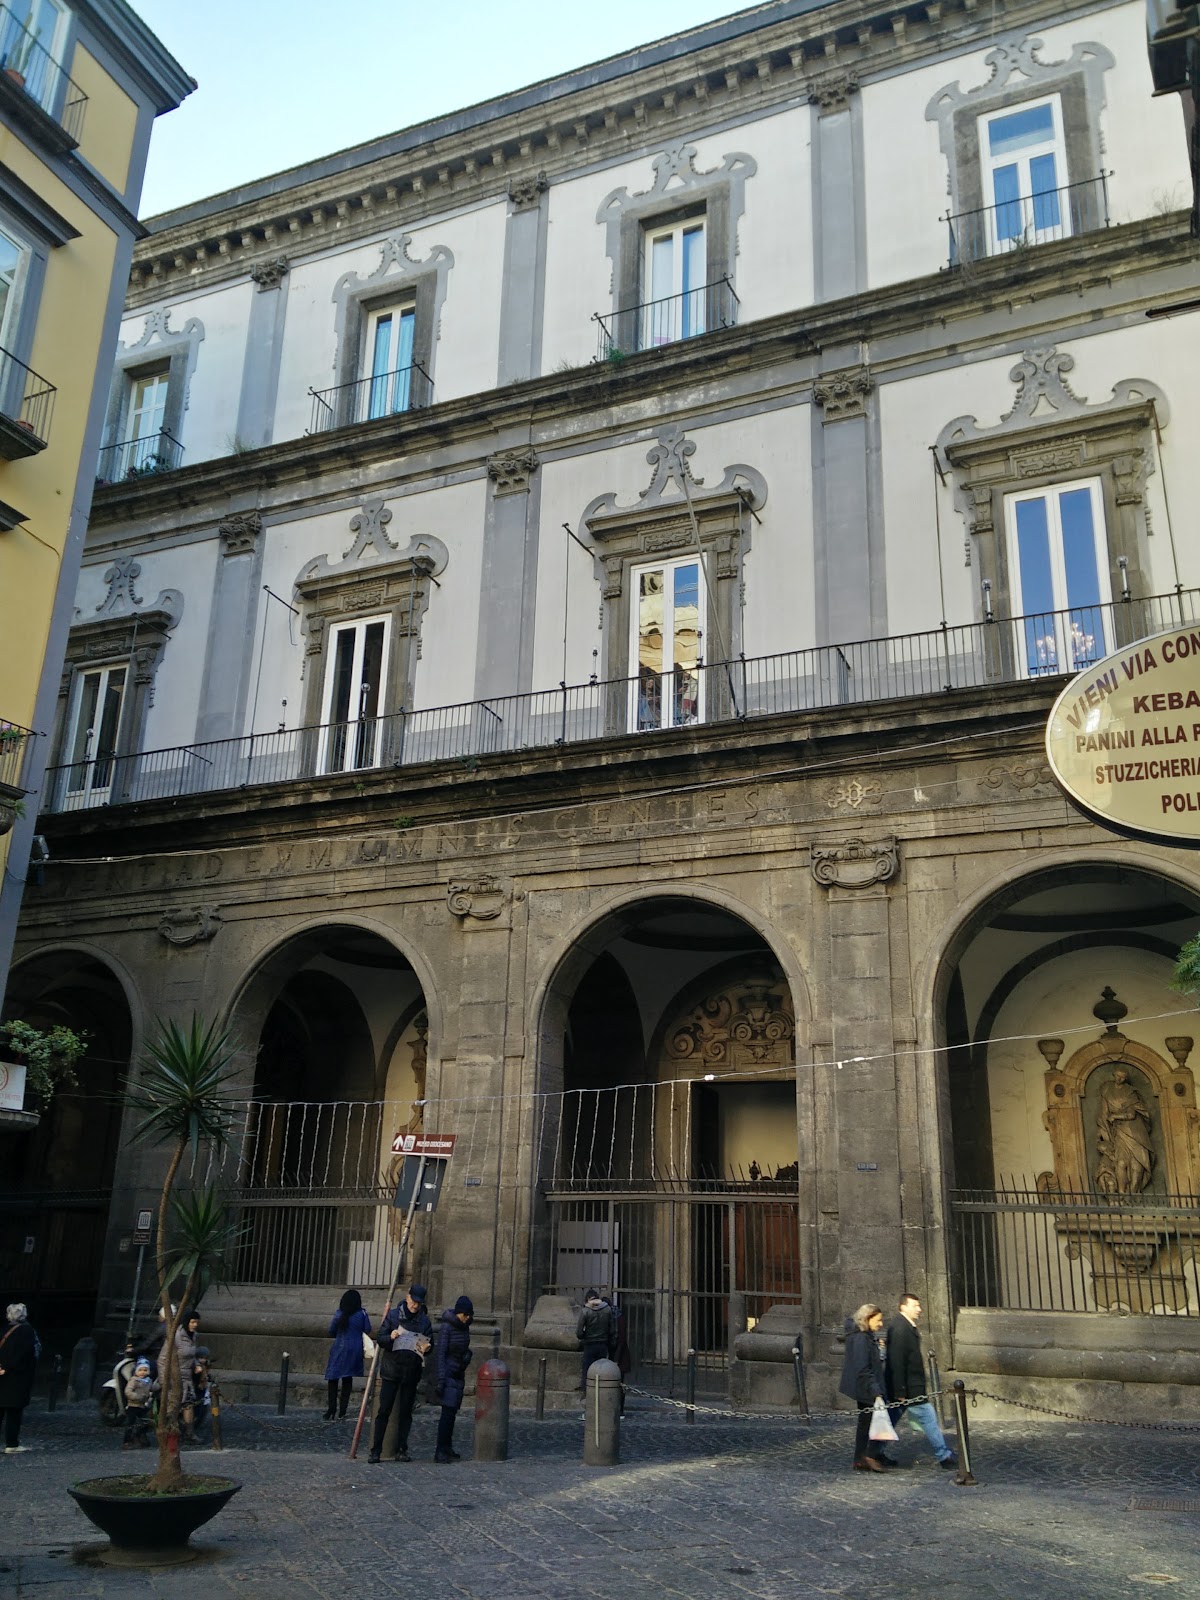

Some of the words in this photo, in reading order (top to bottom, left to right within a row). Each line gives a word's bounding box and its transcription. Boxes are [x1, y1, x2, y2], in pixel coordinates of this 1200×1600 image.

[1066, 668, 1119, 730] VIENI
[1121, 648, 1158, 681] VIA
[1162, 632, 1200, 664] CON
[1133, 690, 1200, 714] KEBA
[1076, 730, 1135, 753] PANINI
[1141, 725, 1188, 747] ALLA
[1095, 757, 1200, 784] STUZZICHERI
[553, 789, 760, 840] GENTES
